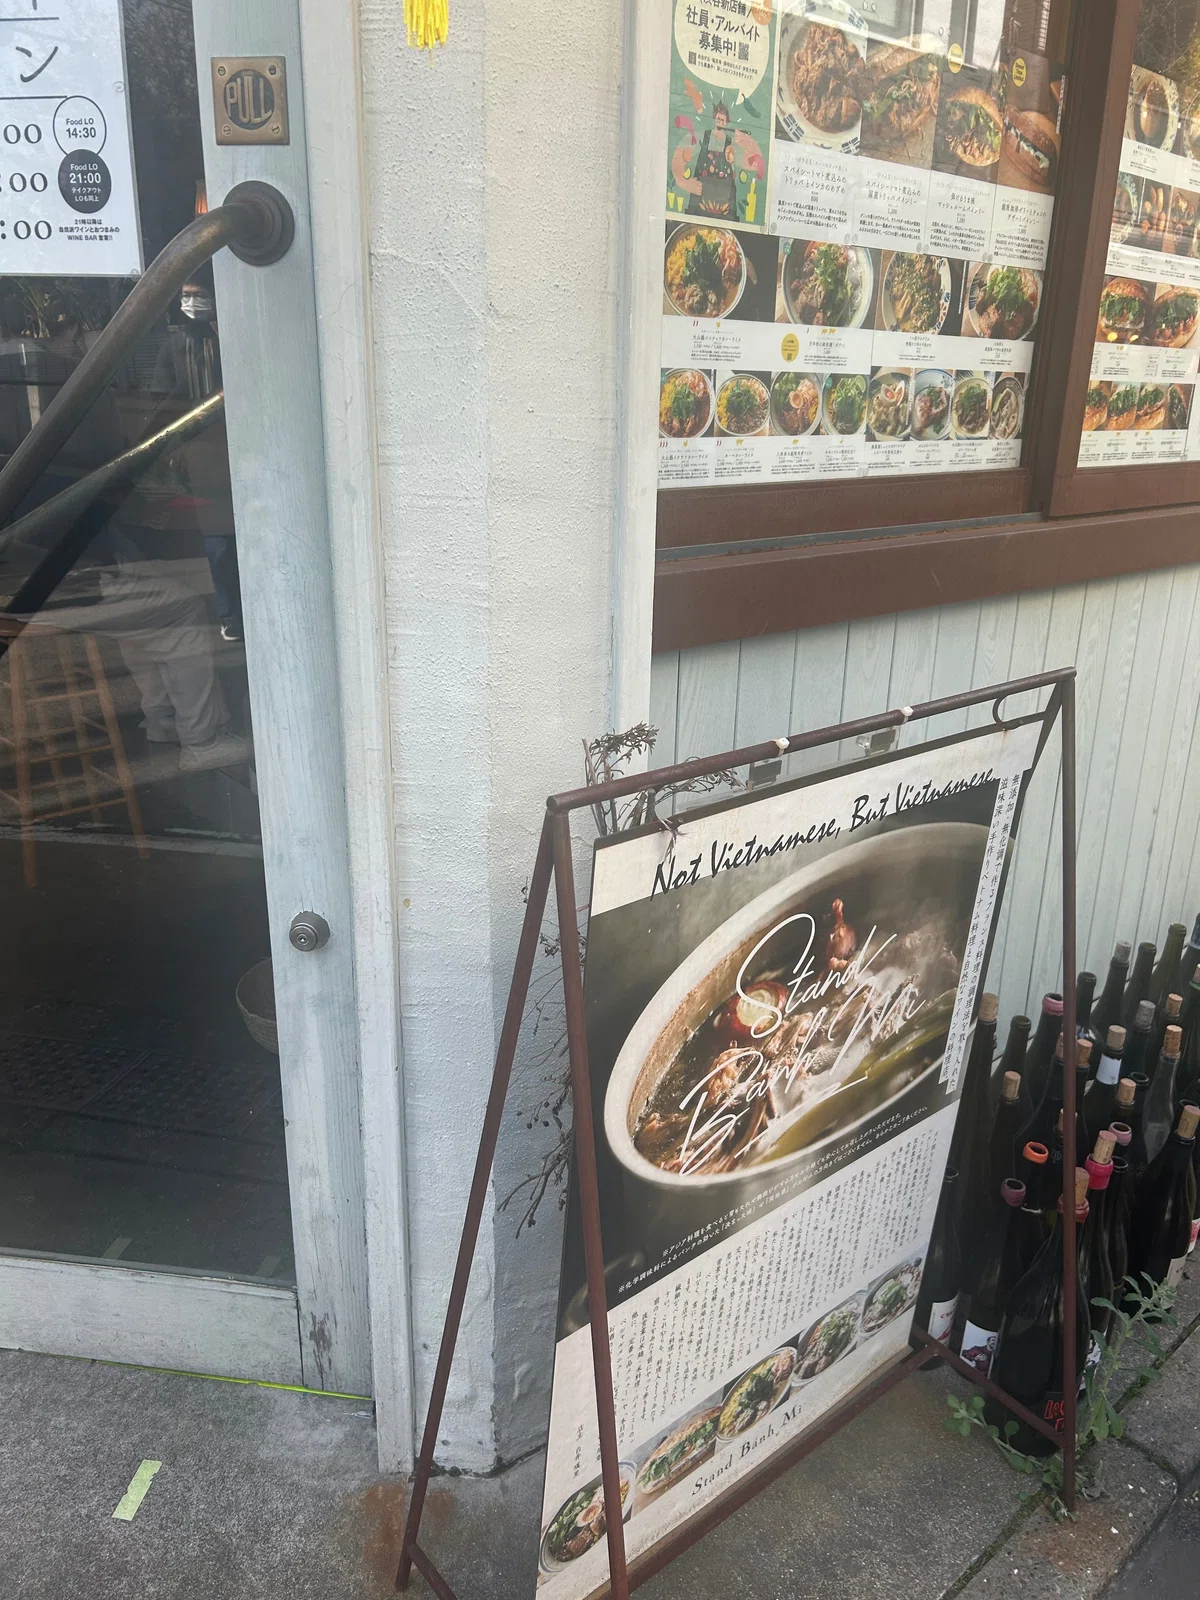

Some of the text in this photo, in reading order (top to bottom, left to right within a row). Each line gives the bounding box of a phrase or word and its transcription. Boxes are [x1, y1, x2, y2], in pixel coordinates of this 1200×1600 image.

[686, 5, 760, 42] 社員・アルバイト
[699, 30, 737, 57] 募集中!
[225, 74, 273, 124] PULL
[66, 127, 97, 138] 14:30
[84, 117, 94, 125] LO
[69, 172, 102, 184] 21:00
[70, 163, 87, 171] Food
[650, 853, 702, 902] Not
[711, 818, 841, 875] Vietnamese,
[849, 795, 890, 833] But
[735, 913, 898, 1039] Stand
[692, 1454, 733, 1496] Stand
